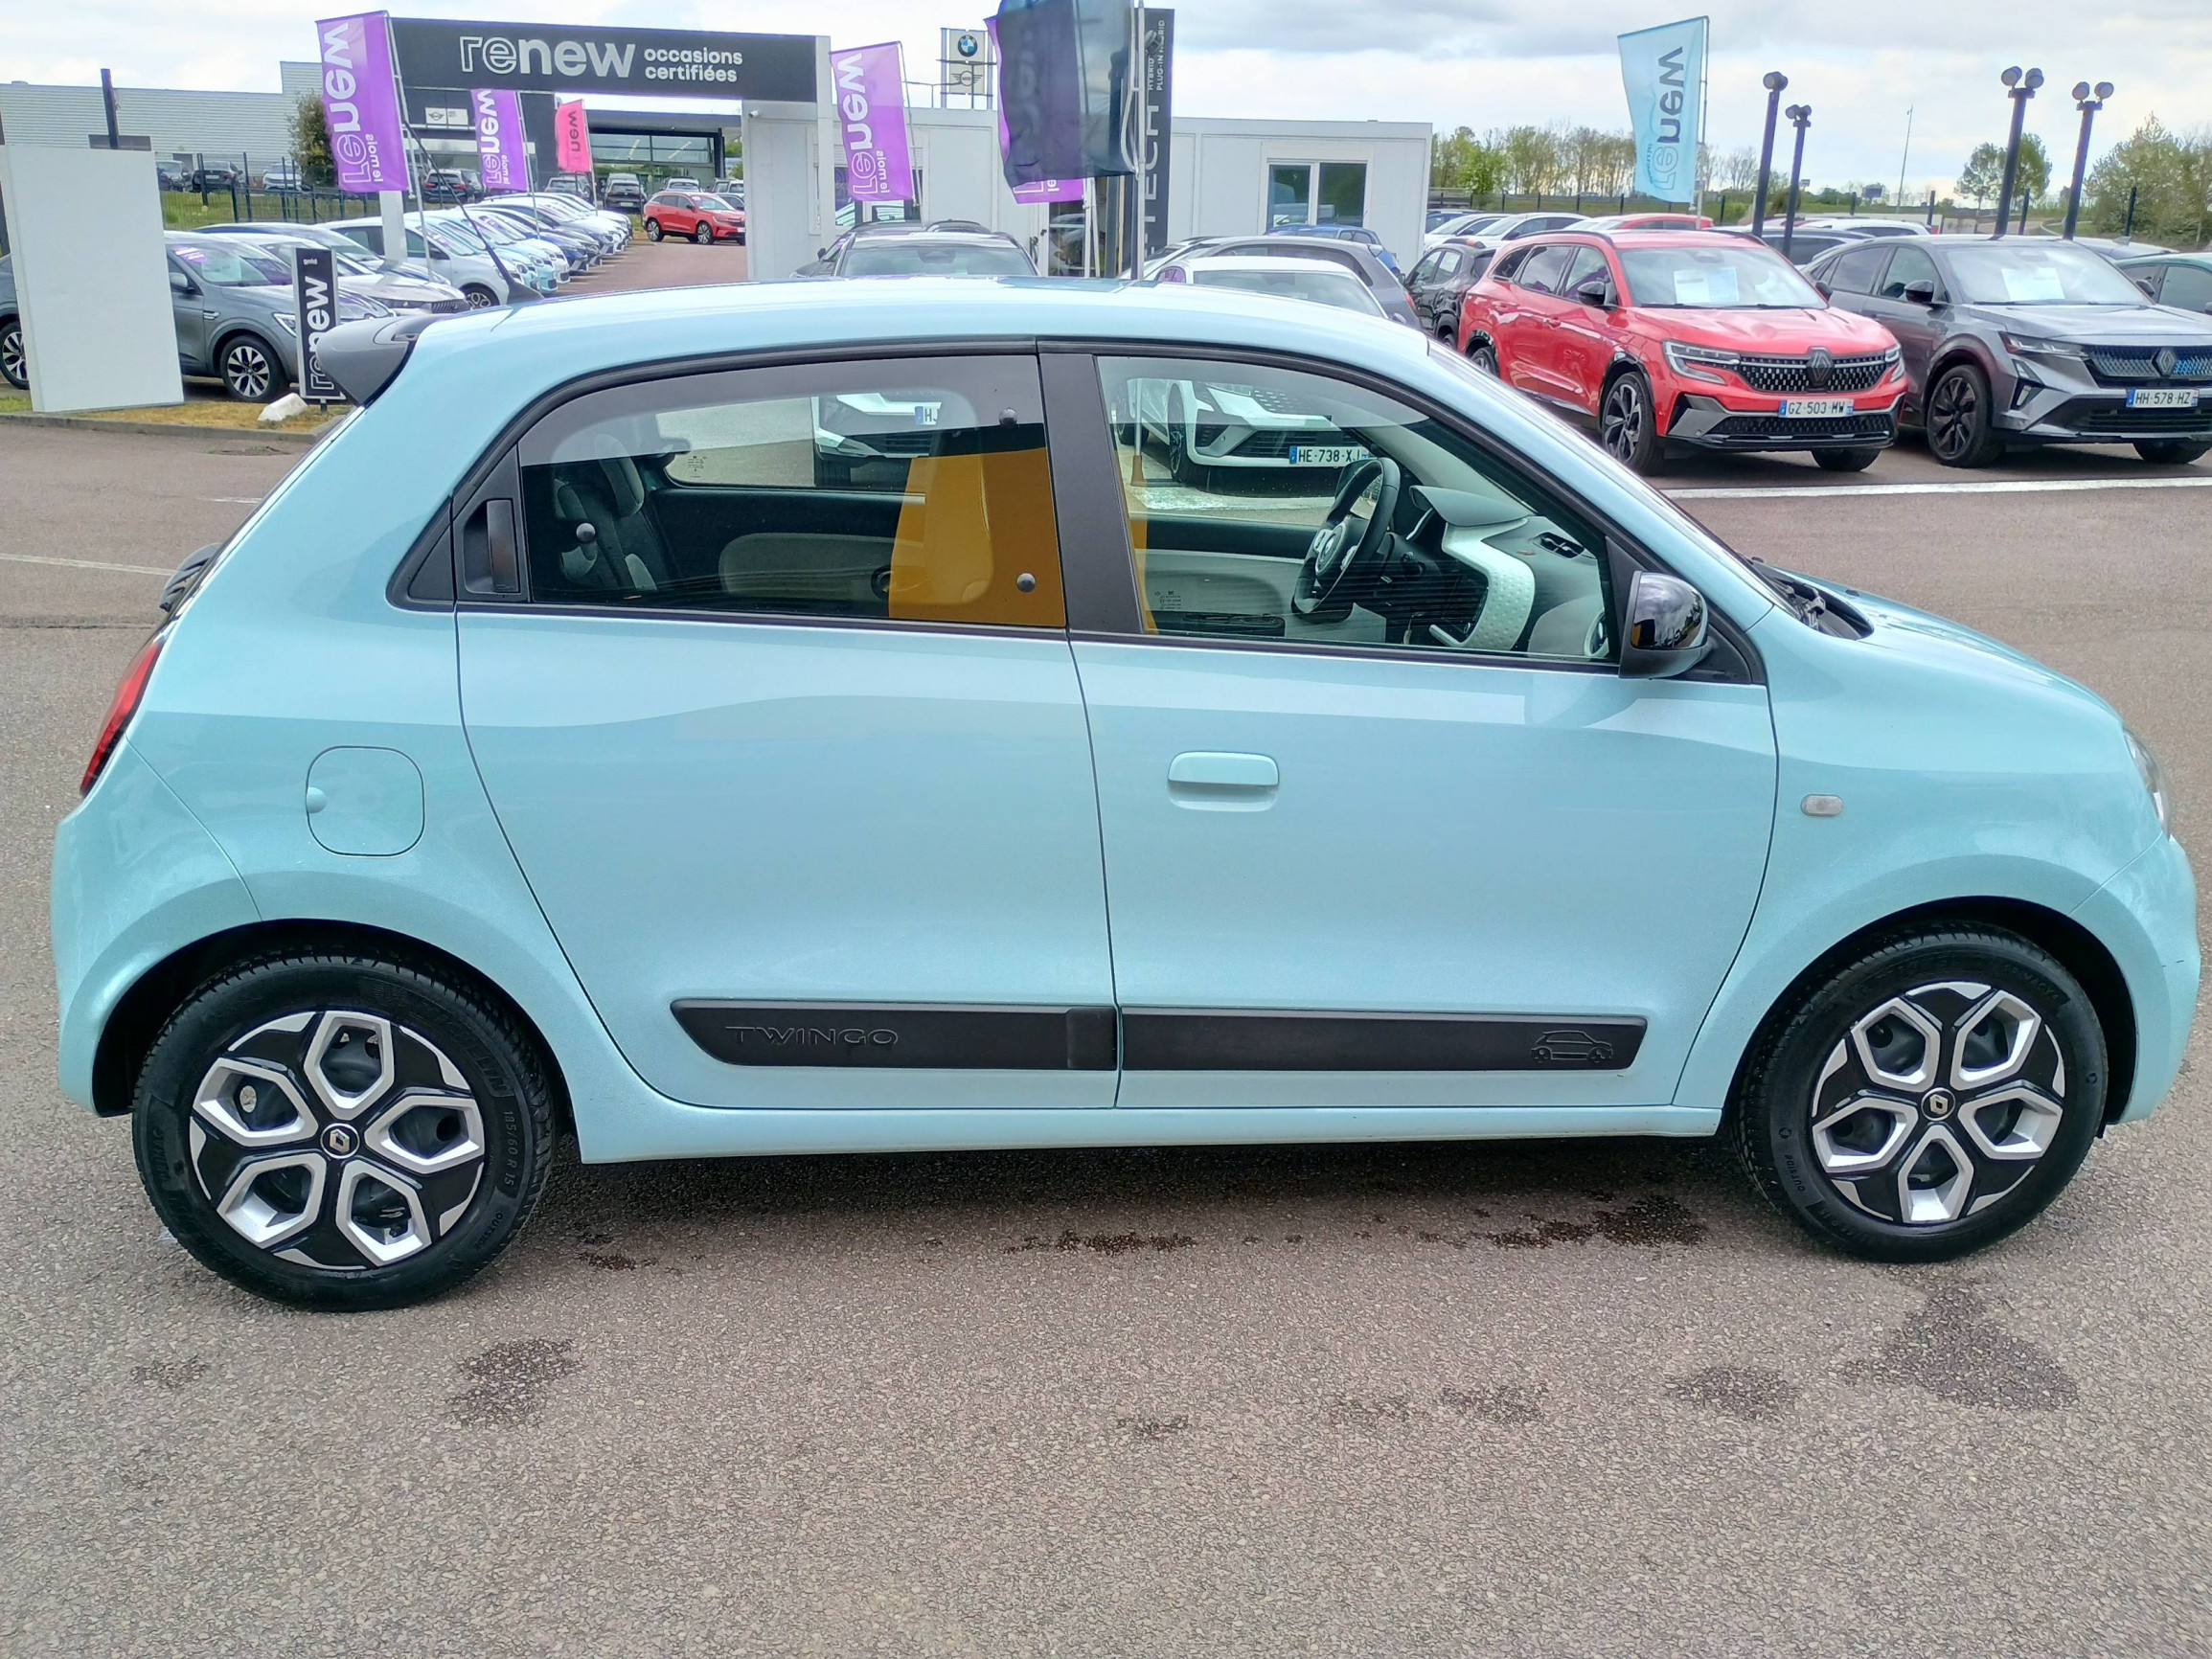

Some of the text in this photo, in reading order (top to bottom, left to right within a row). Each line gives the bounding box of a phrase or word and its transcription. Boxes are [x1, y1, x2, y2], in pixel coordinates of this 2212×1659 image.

[459, 35, 636, 79] renew
[644, 46, 743, 65] occasions
[645, 64, 738, 82] certifiées
[2135, 392, 2191, 404] HH-578-HZ
[725, 1026, 899, 1046] TWINGO
